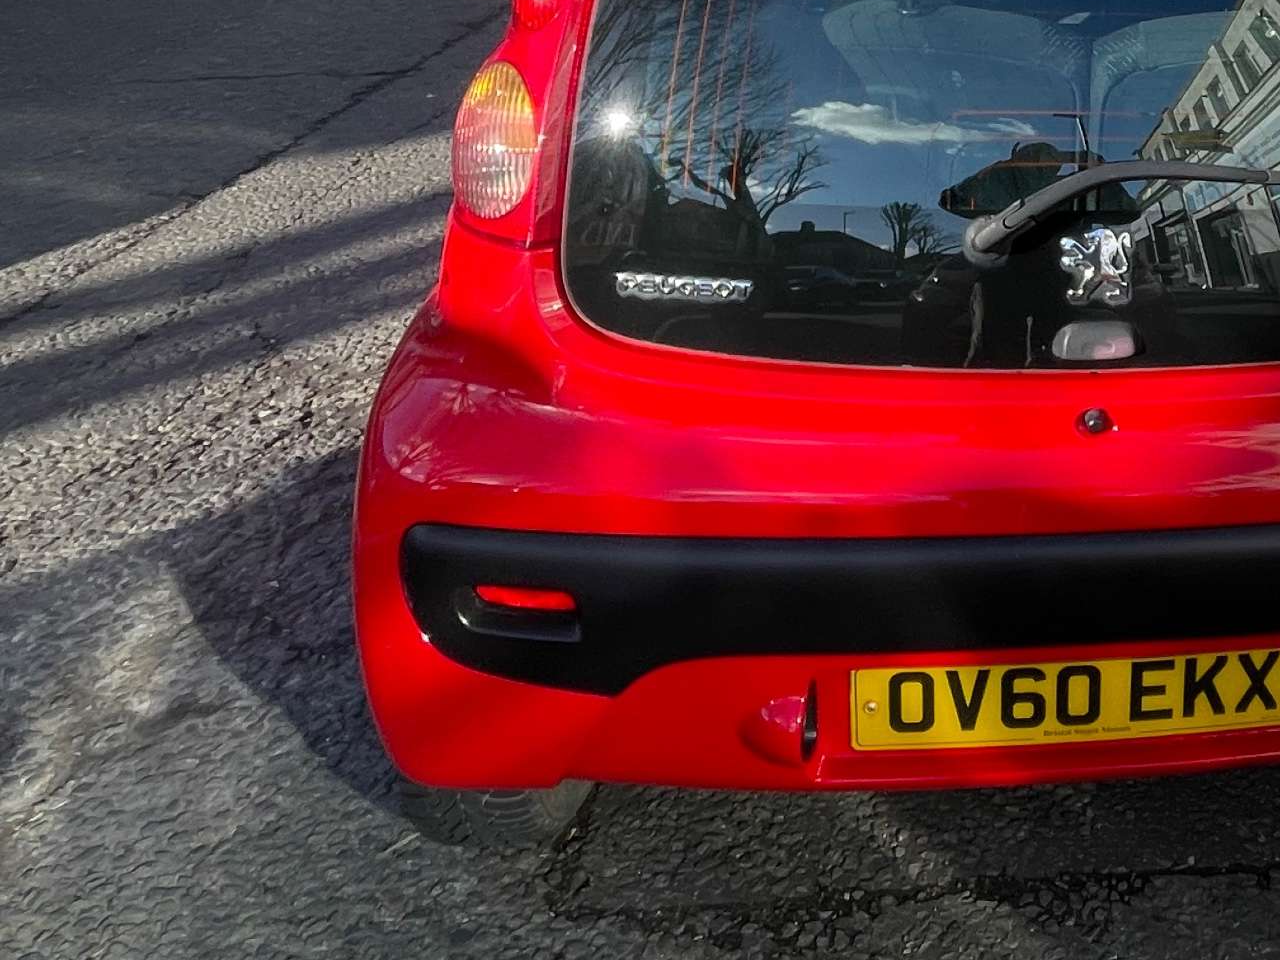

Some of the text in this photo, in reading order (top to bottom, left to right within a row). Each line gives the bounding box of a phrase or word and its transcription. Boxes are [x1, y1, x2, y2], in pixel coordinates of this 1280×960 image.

[616, 272, 754, 303] PEUGEOT
[888, 651, 1280, 733] OV60 EKX
